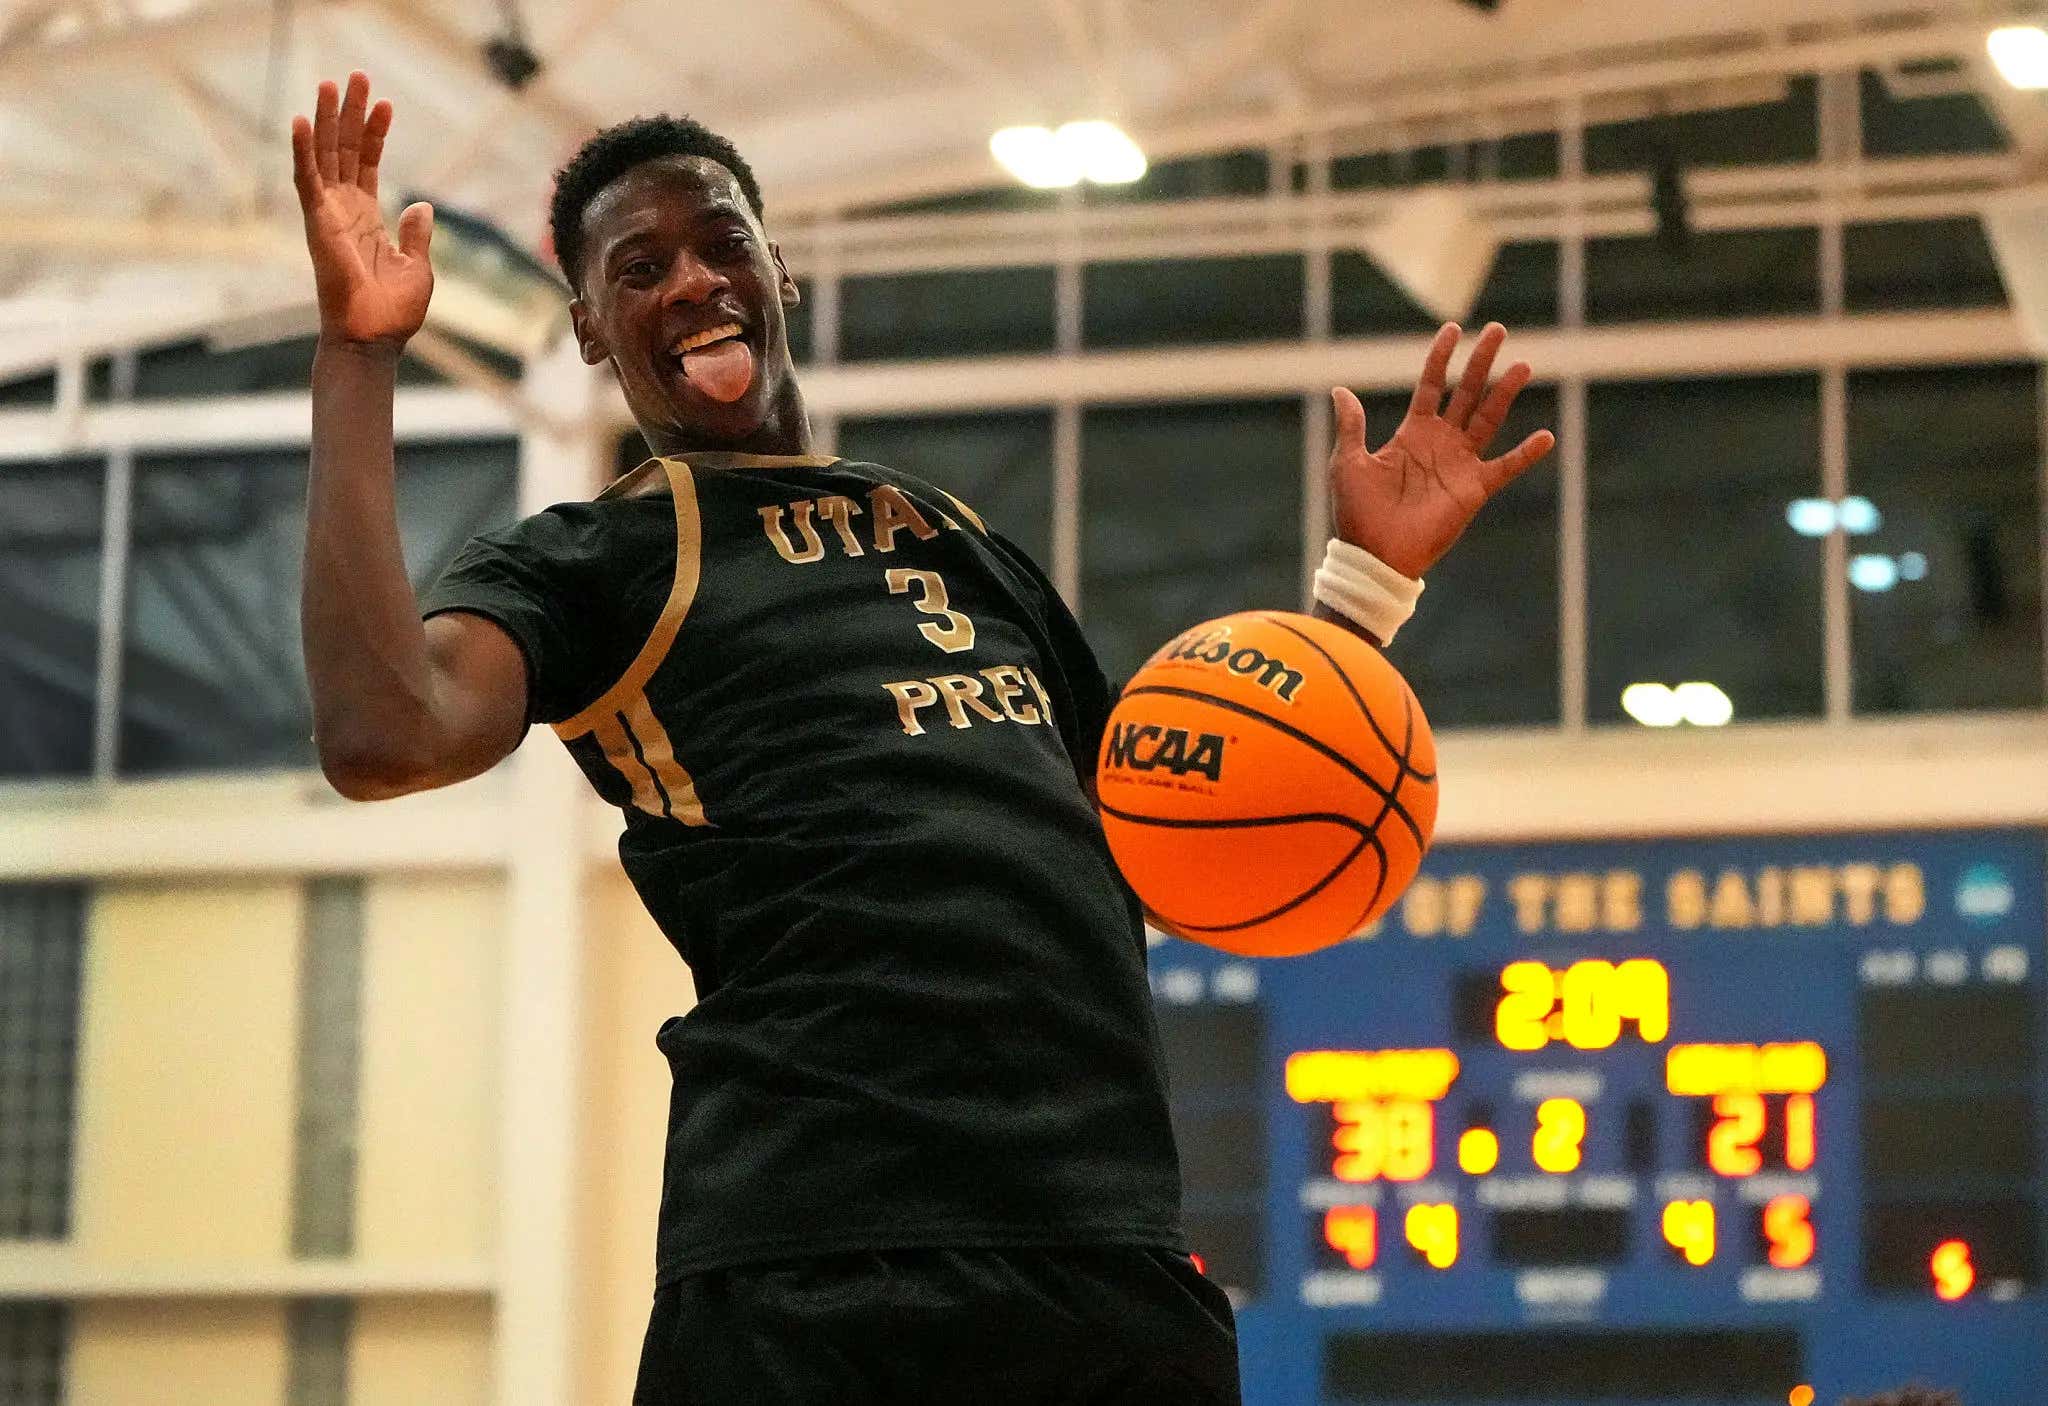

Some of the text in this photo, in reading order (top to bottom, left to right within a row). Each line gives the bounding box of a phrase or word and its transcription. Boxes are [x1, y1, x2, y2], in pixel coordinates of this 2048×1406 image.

[758, 484, 961, 564] UTA
[884, 567, 976, 654] 3
[1105, 721, 1224, 782] NCAA
[1402, 874, 1486, 938] OF
[1508, 869, 1642, 934] THE
[1667, 862, 1925, 930] SAINTS
[1708, 1092, 1816, 1177] 21
